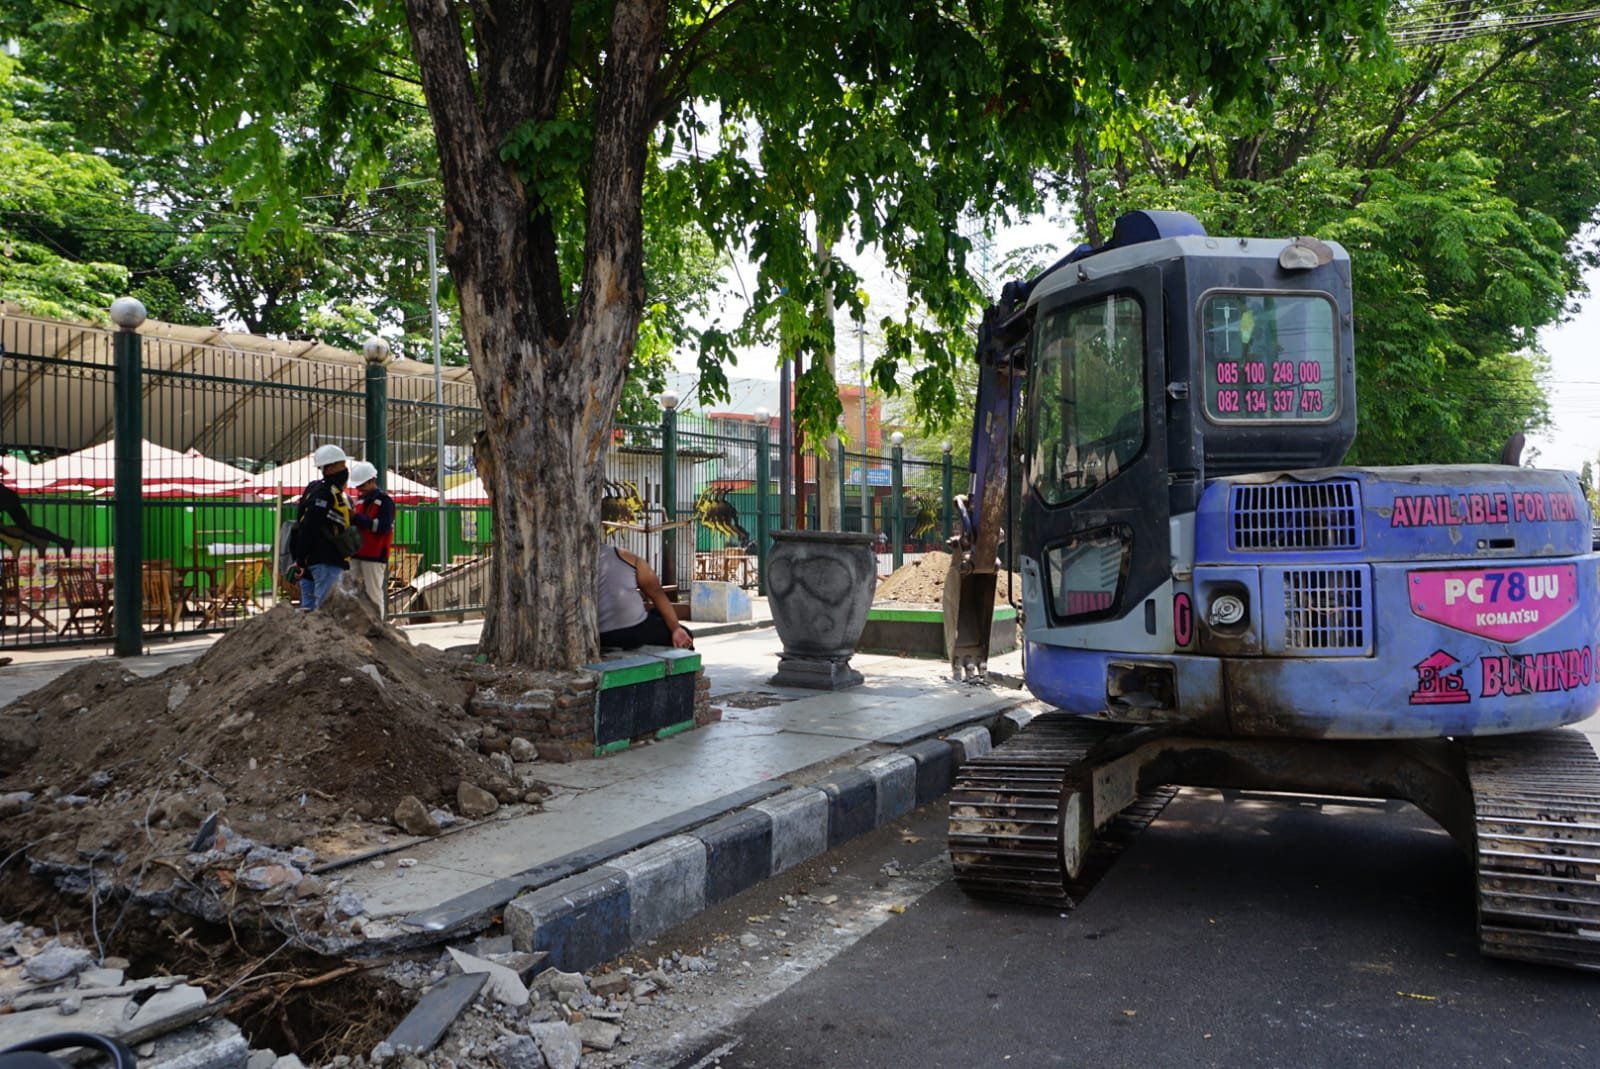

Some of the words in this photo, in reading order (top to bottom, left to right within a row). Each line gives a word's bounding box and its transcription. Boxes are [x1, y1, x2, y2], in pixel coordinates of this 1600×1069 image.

[1217, 362, 1239, 384] 085
[1244, 362, 1265, 384] 100
[1272, 361, 1294, 384] 248
[1299, 361, 1320, 383] 000
[1218, 390, 1240, 412] 082
[1245, 390, 1266, 412] 134
[1273, 390, 1294, 412] 337
[1301, 390, 1322, 412] 473
[1391, 492, 1509, 528] AVAILABLE
[1513, 492, 1547, 523] FOR
[1444, 572, 1559, 605] PC78UU
[1476, 608, 1539, 626] KOMATSU
[1480, 645, 1592, 698] BUMINDO
